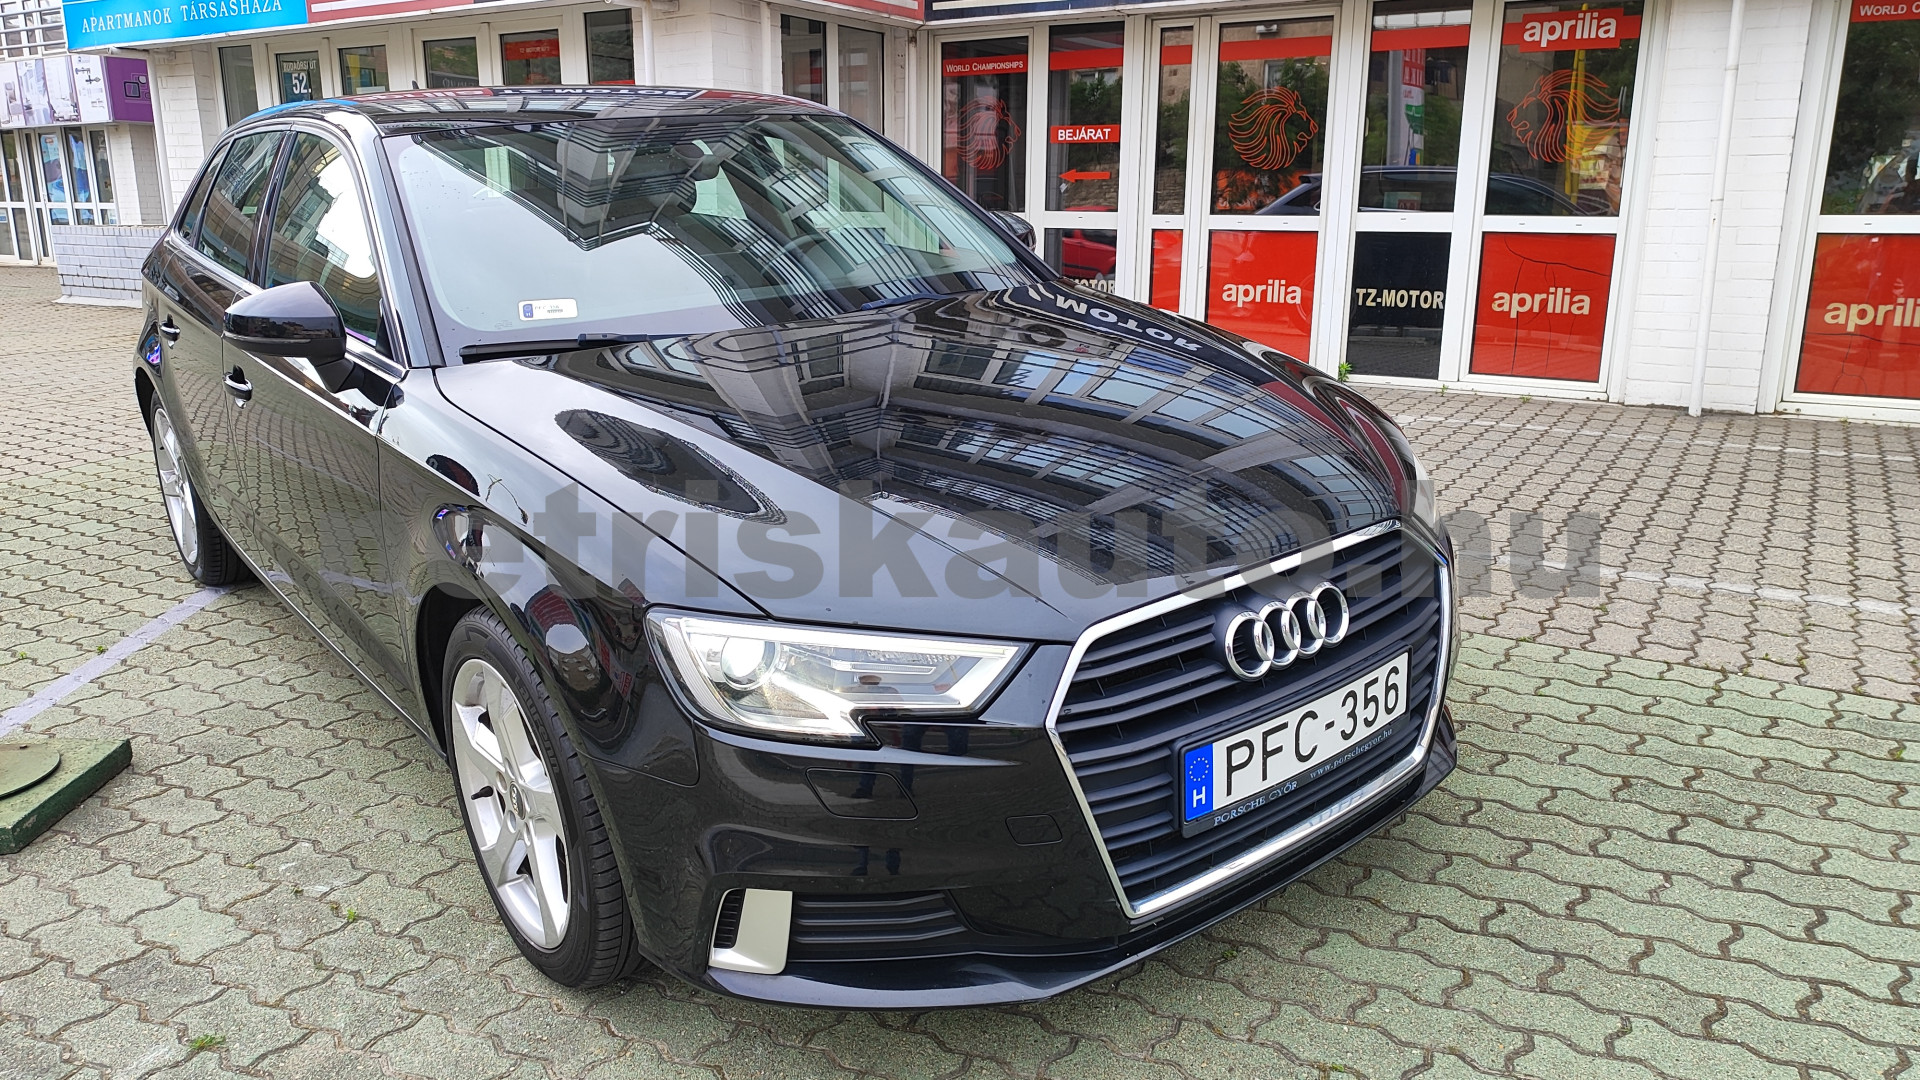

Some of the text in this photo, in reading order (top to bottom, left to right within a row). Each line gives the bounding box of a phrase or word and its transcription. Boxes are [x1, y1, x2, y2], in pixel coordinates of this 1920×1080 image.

[82, 8, 173, 34] APARTMANOK
[1523, 12, 1617, 48] aprilia
[946, 61, 1024, 73] WORLD CHAMPIONSHIPS
[292, 72, 312, 94] 52.
[1057, 126, 1112, 141] BEJÁRAT
[1222, 279, 1302, 308] aprilia
[1355, 288, 1445, 310] TZ-MOTOR
[1491, 286, 1591, 319] aprilia
[1823, 297, 1920, 332] aprili
[1226, 665, 1400, 797] PFC-356
[1192, 786, 1206, 808] H
[1213, 795, 1266, 827] PORSCHE
